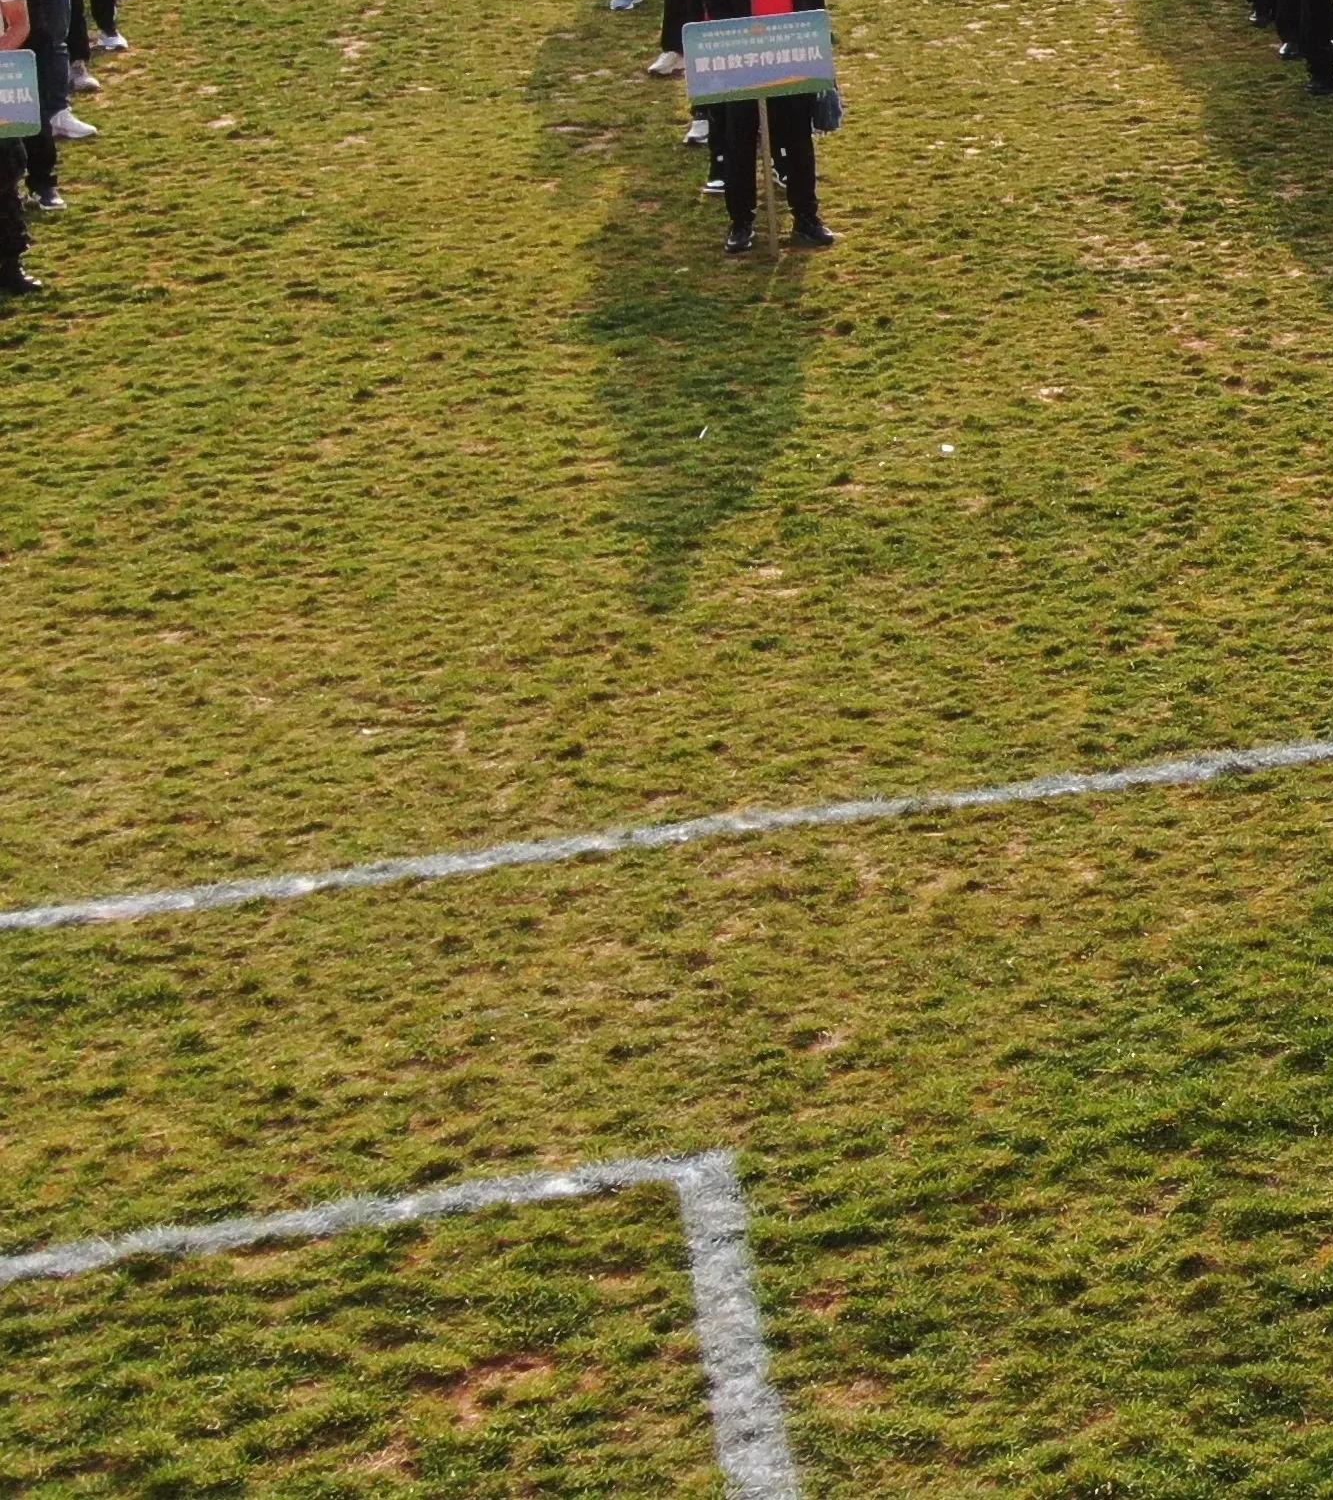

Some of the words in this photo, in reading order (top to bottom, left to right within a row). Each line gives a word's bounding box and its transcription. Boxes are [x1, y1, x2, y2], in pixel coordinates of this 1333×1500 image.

[694, 45, 823, 73] 蒙自数字传媒联队
